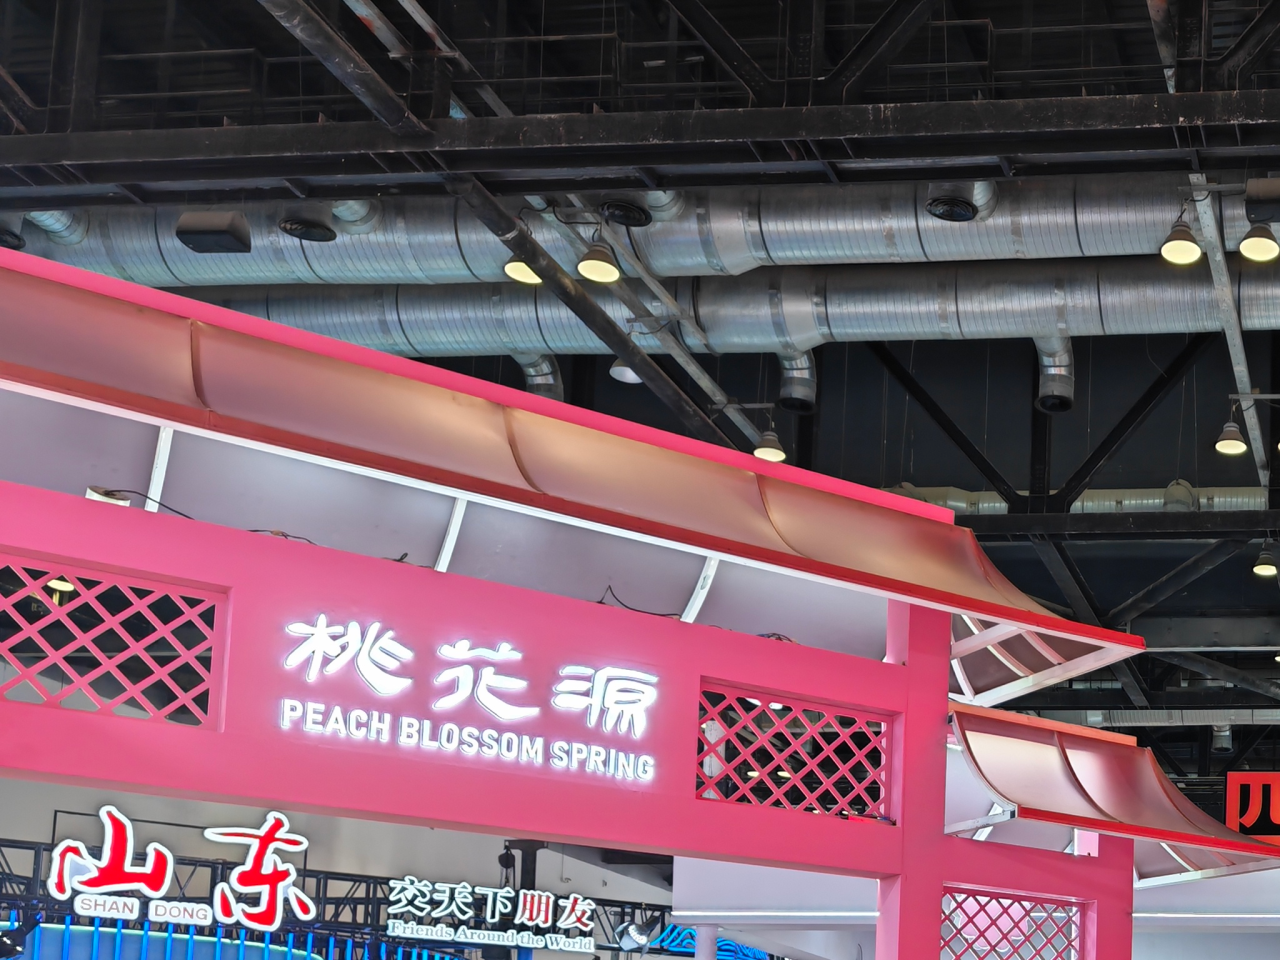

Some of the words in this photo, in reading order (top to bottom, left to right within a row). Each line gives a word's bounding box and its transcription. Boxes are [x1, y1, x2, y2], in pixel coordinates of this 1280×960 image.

[284, 613, 659, 739] 桃花源
[281, 699, 391, 742] PEACH
[399, 716, 544, 765] BLOSSOM
[549, 740, 655, 782] SPRING
[47, 804, 317, 933] 山东
[387, 875, 597, 932] 交天下朋友
[80, 898, 135, 915] SHAN
[154, 904, 208, 921] DONG
[389, 921, 453, 939] Friends
[457, 926, 514, 944] Around
[517, 931, 544, 947] the
[548, 934, 593, 951] World
